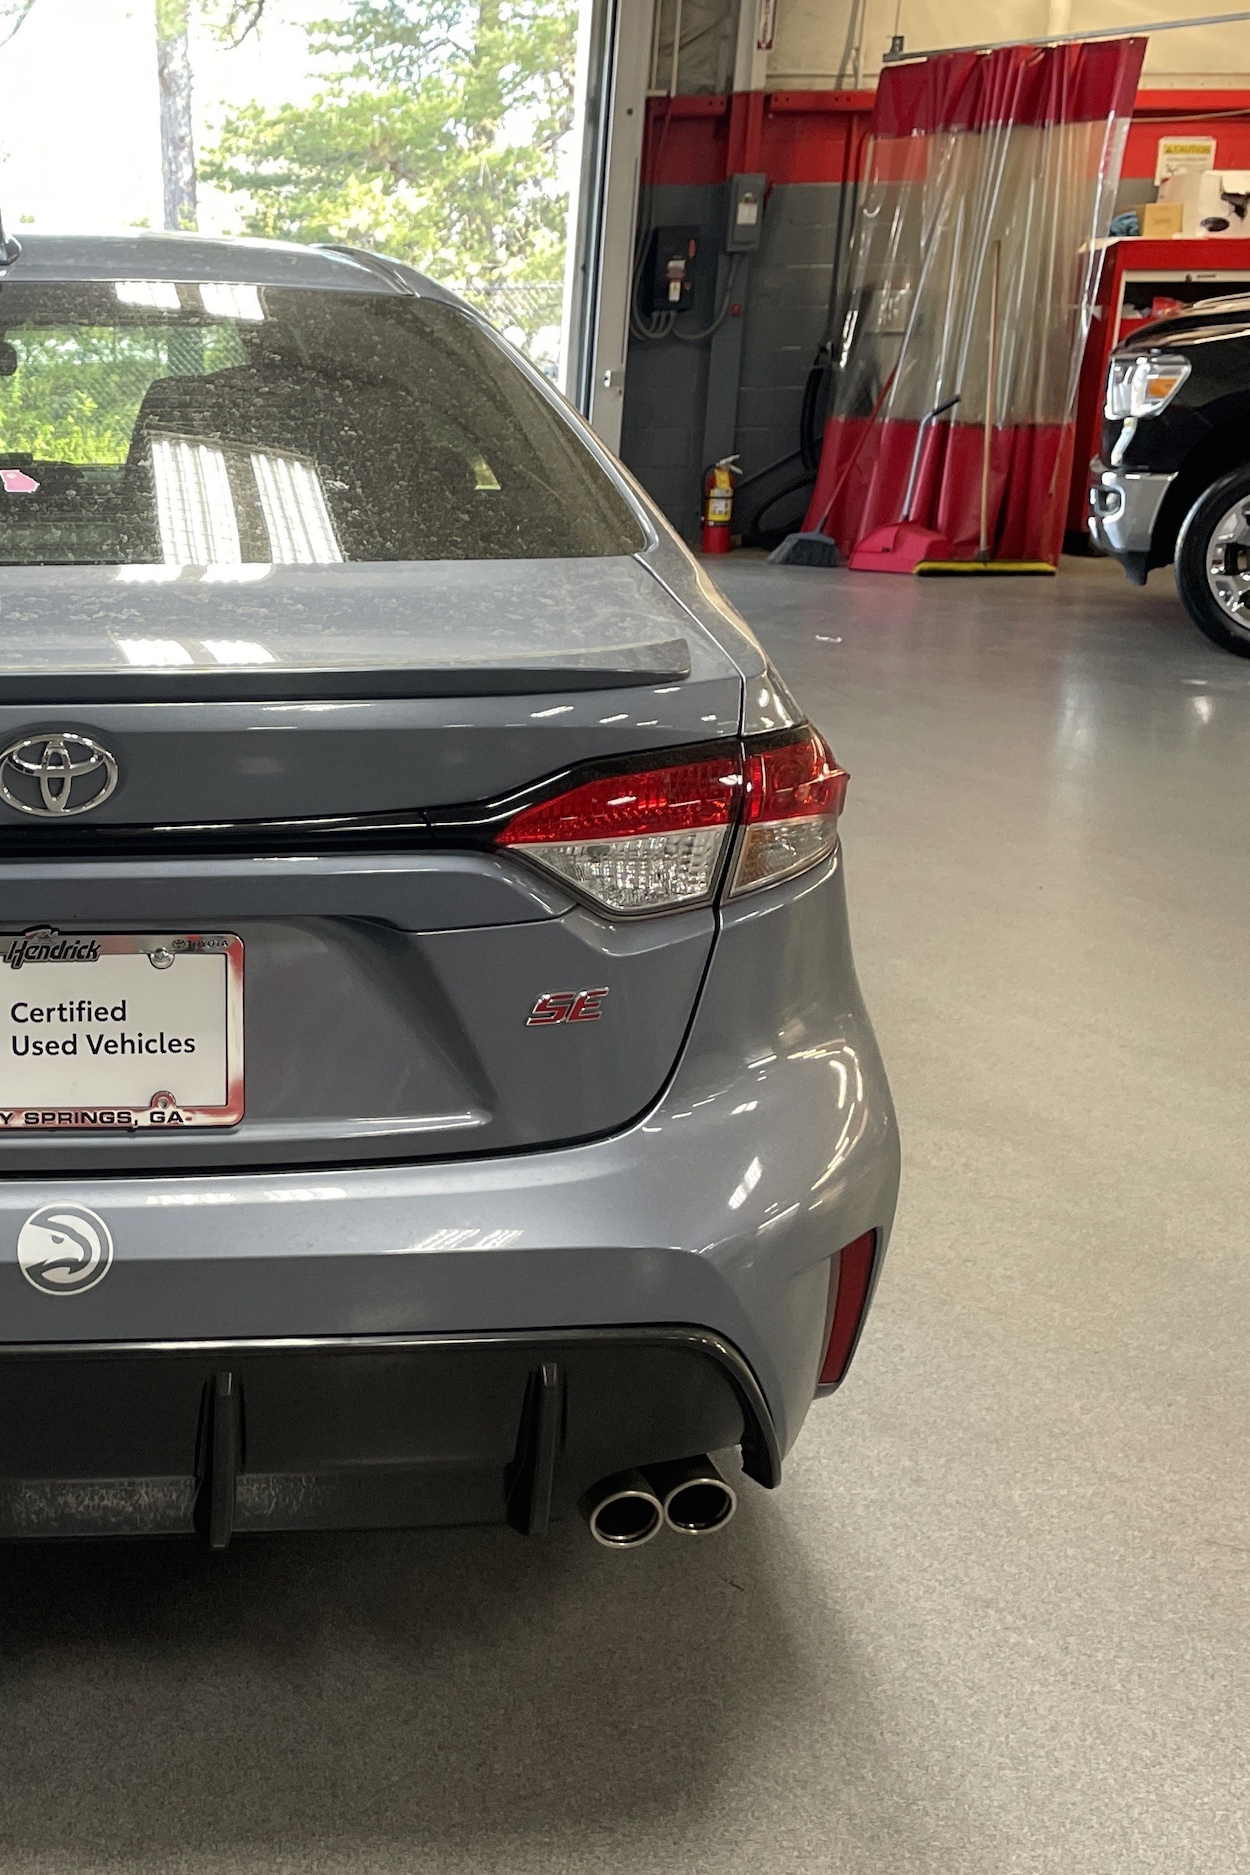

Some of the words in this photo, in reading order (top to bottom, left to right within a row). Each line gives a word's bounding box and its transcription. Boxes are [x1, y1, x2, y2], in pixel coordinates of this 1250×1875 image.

[6, 939, 102, 968] Hendrick
[187, 938, 229, 949] TOYOTA
[10, 999, 127, 1024] Certified
[526, 987, 610, 1026] SE
[11, 1033, 78, 1057] Used
[86, 1031, 196, 1055] Vehicles
[24, 1110, 139, 1126] SPRINGS,
[149, 1110, 184, 1124] GA
